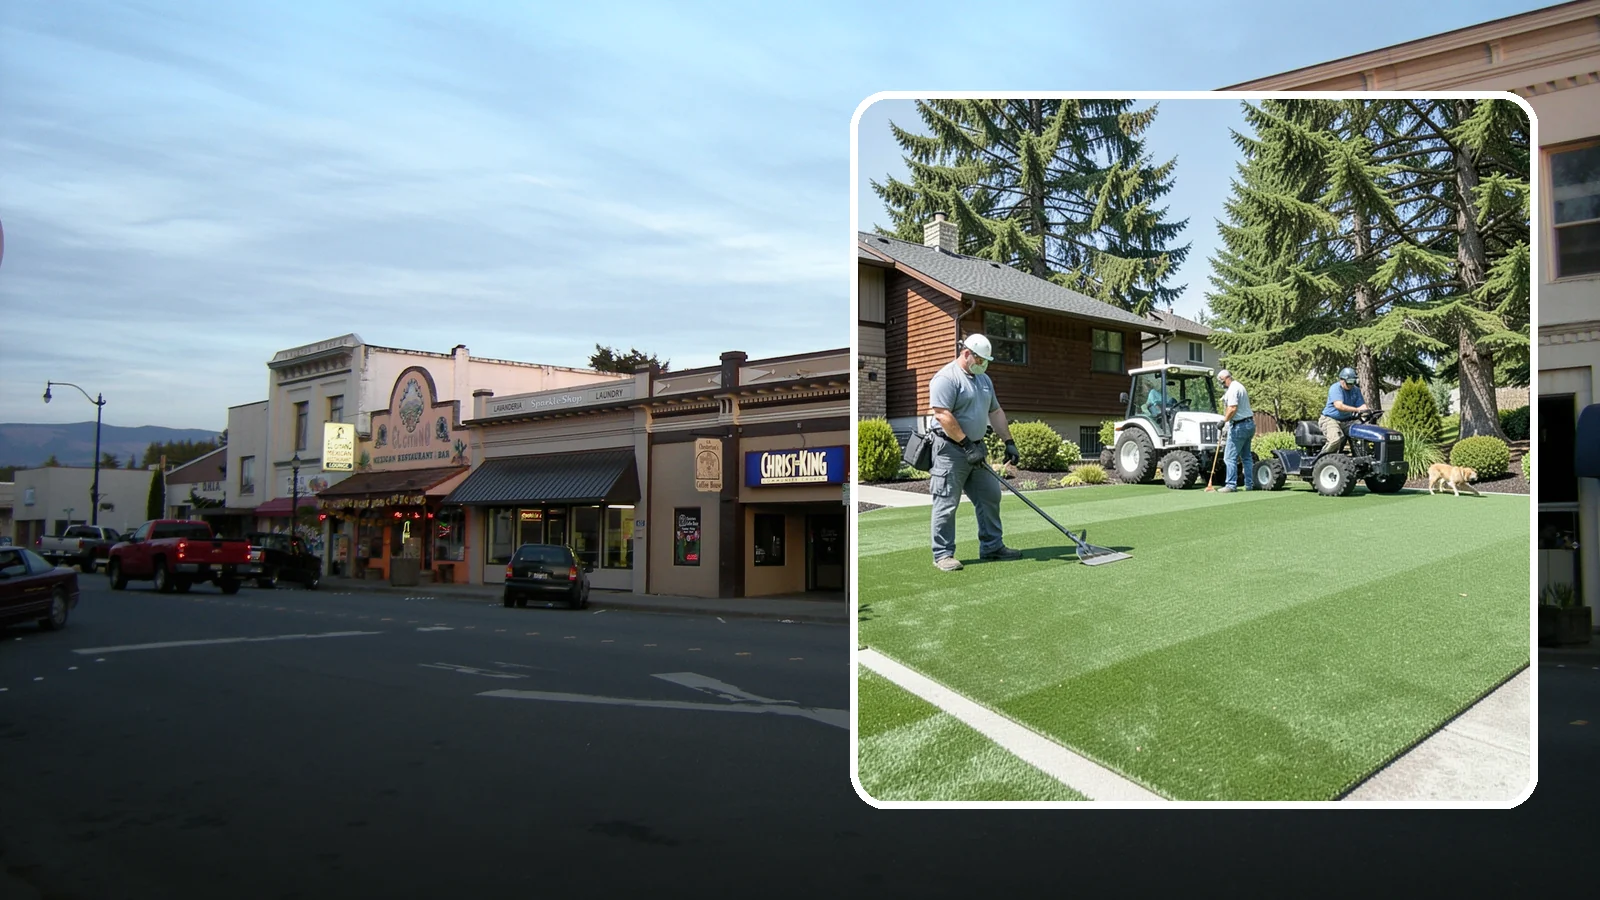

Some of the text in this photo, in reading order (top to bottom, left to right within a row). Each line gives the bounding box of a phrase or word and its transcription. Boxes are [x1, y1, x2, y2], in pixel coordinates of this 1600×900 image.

[530, 394, 583, 409] Sparkle Shop
[595, 389, 624, 400] LAUNDRY
[493, 402, 522, 412] LAVANDERIA
[373, 450, 450, 464] MEXICAN RESTAURANT BAR
[761, 450, 827, 478] CHRIST KING
